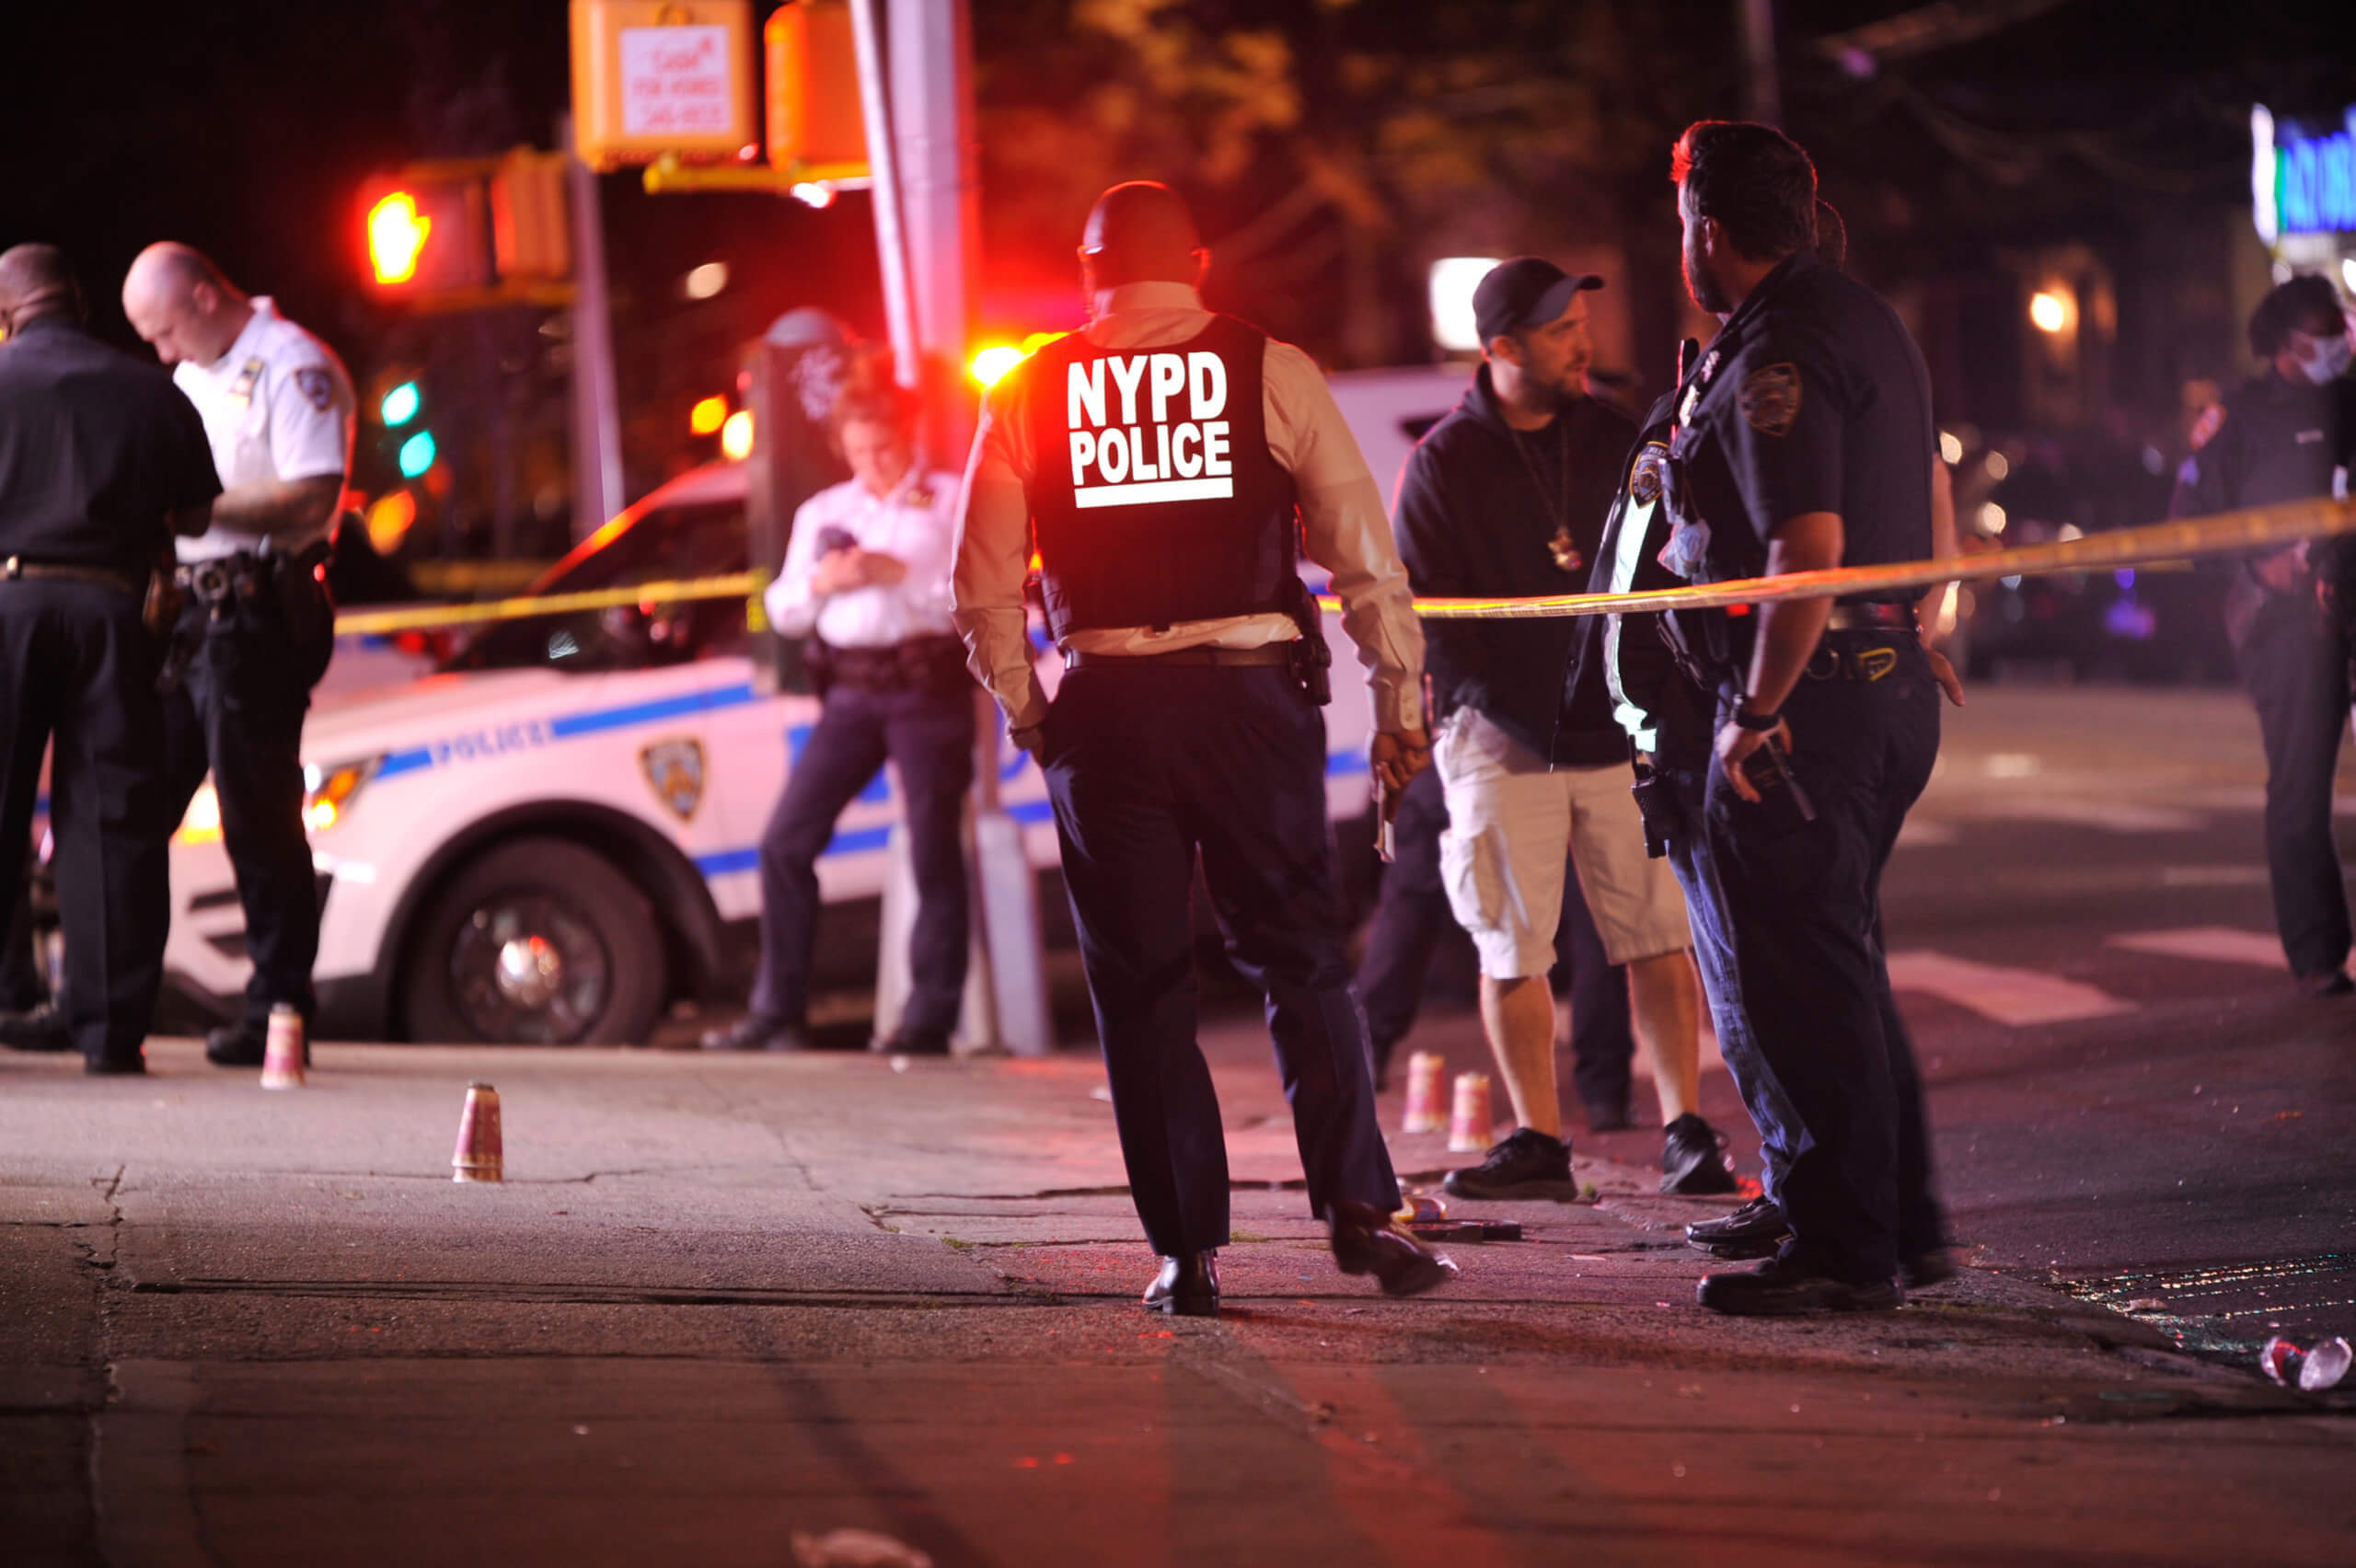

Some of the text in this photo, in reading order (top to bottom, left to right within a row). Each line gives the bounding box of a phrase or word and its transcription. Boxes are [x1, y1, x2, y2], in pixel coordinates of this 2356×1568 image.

[1068, 352, 1227, 429] NYPD
[1069, 421, 1232, 486] POLICE
[436, 721, 548, 765] POLICE
